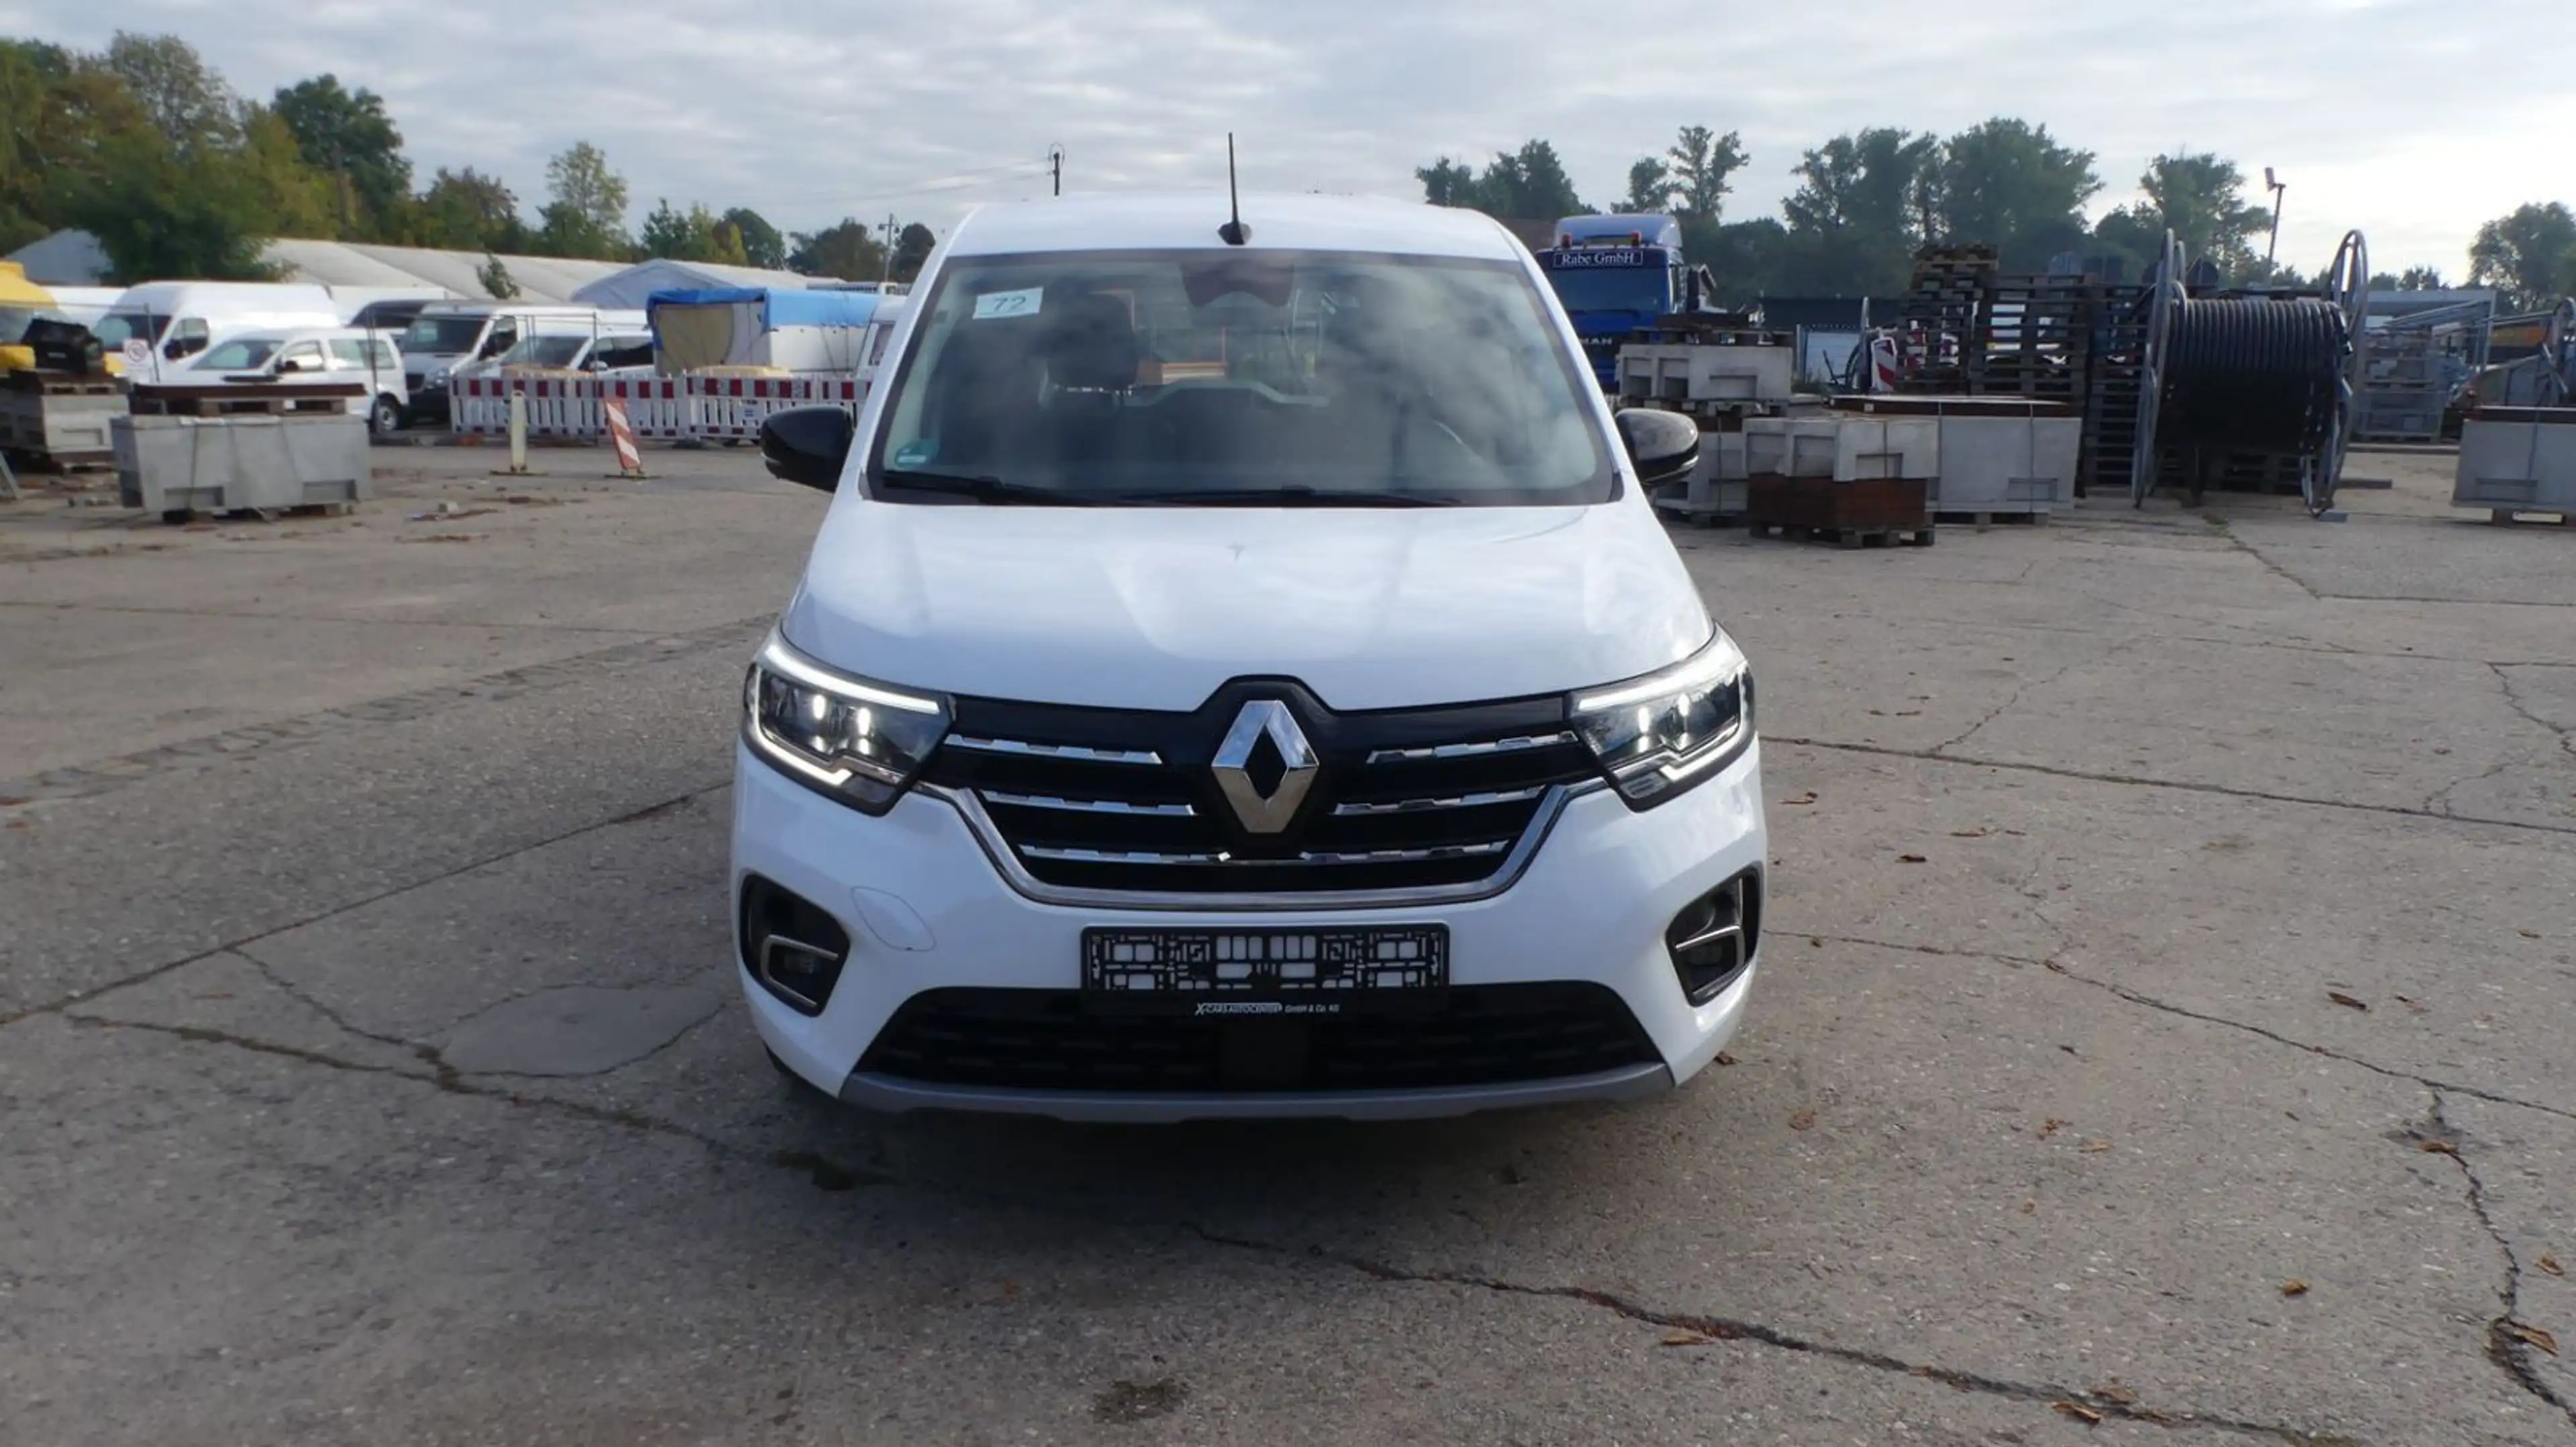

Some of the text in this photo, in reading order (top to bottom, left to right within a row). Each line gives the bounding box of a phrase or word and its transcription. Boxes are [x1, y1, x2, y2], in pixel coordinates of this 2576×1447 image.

[1562, 251, 1634, 265] Rabe GmbH
[994, 296, 1026, 312] 72
